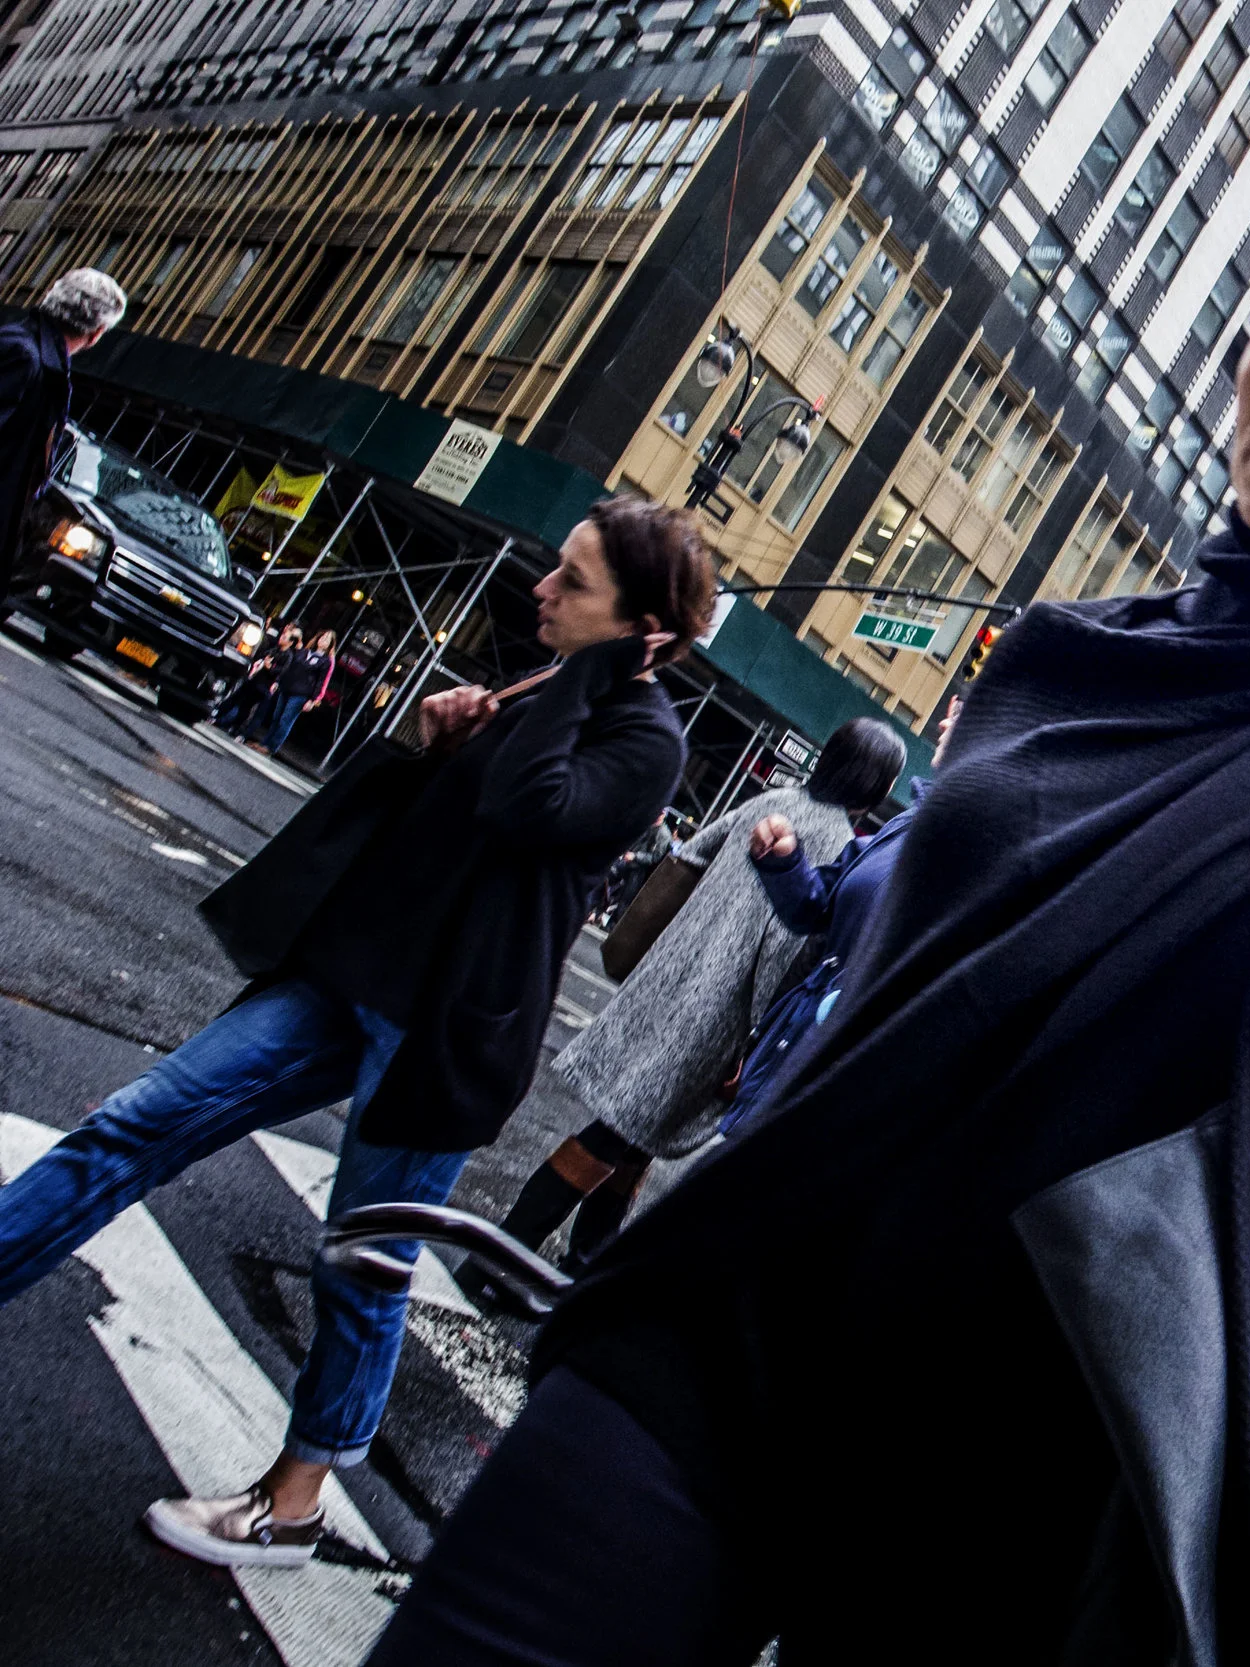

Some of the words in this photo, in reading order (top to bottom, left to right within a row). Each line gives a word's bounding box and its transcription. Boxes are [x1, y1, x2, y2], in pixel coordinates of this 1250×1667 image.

[447, 433, 488, 460] EVEREST
[872, 619, 887, 636] W
[885, 623, 903, 640] 39
[902, 627, 918, 644] St
